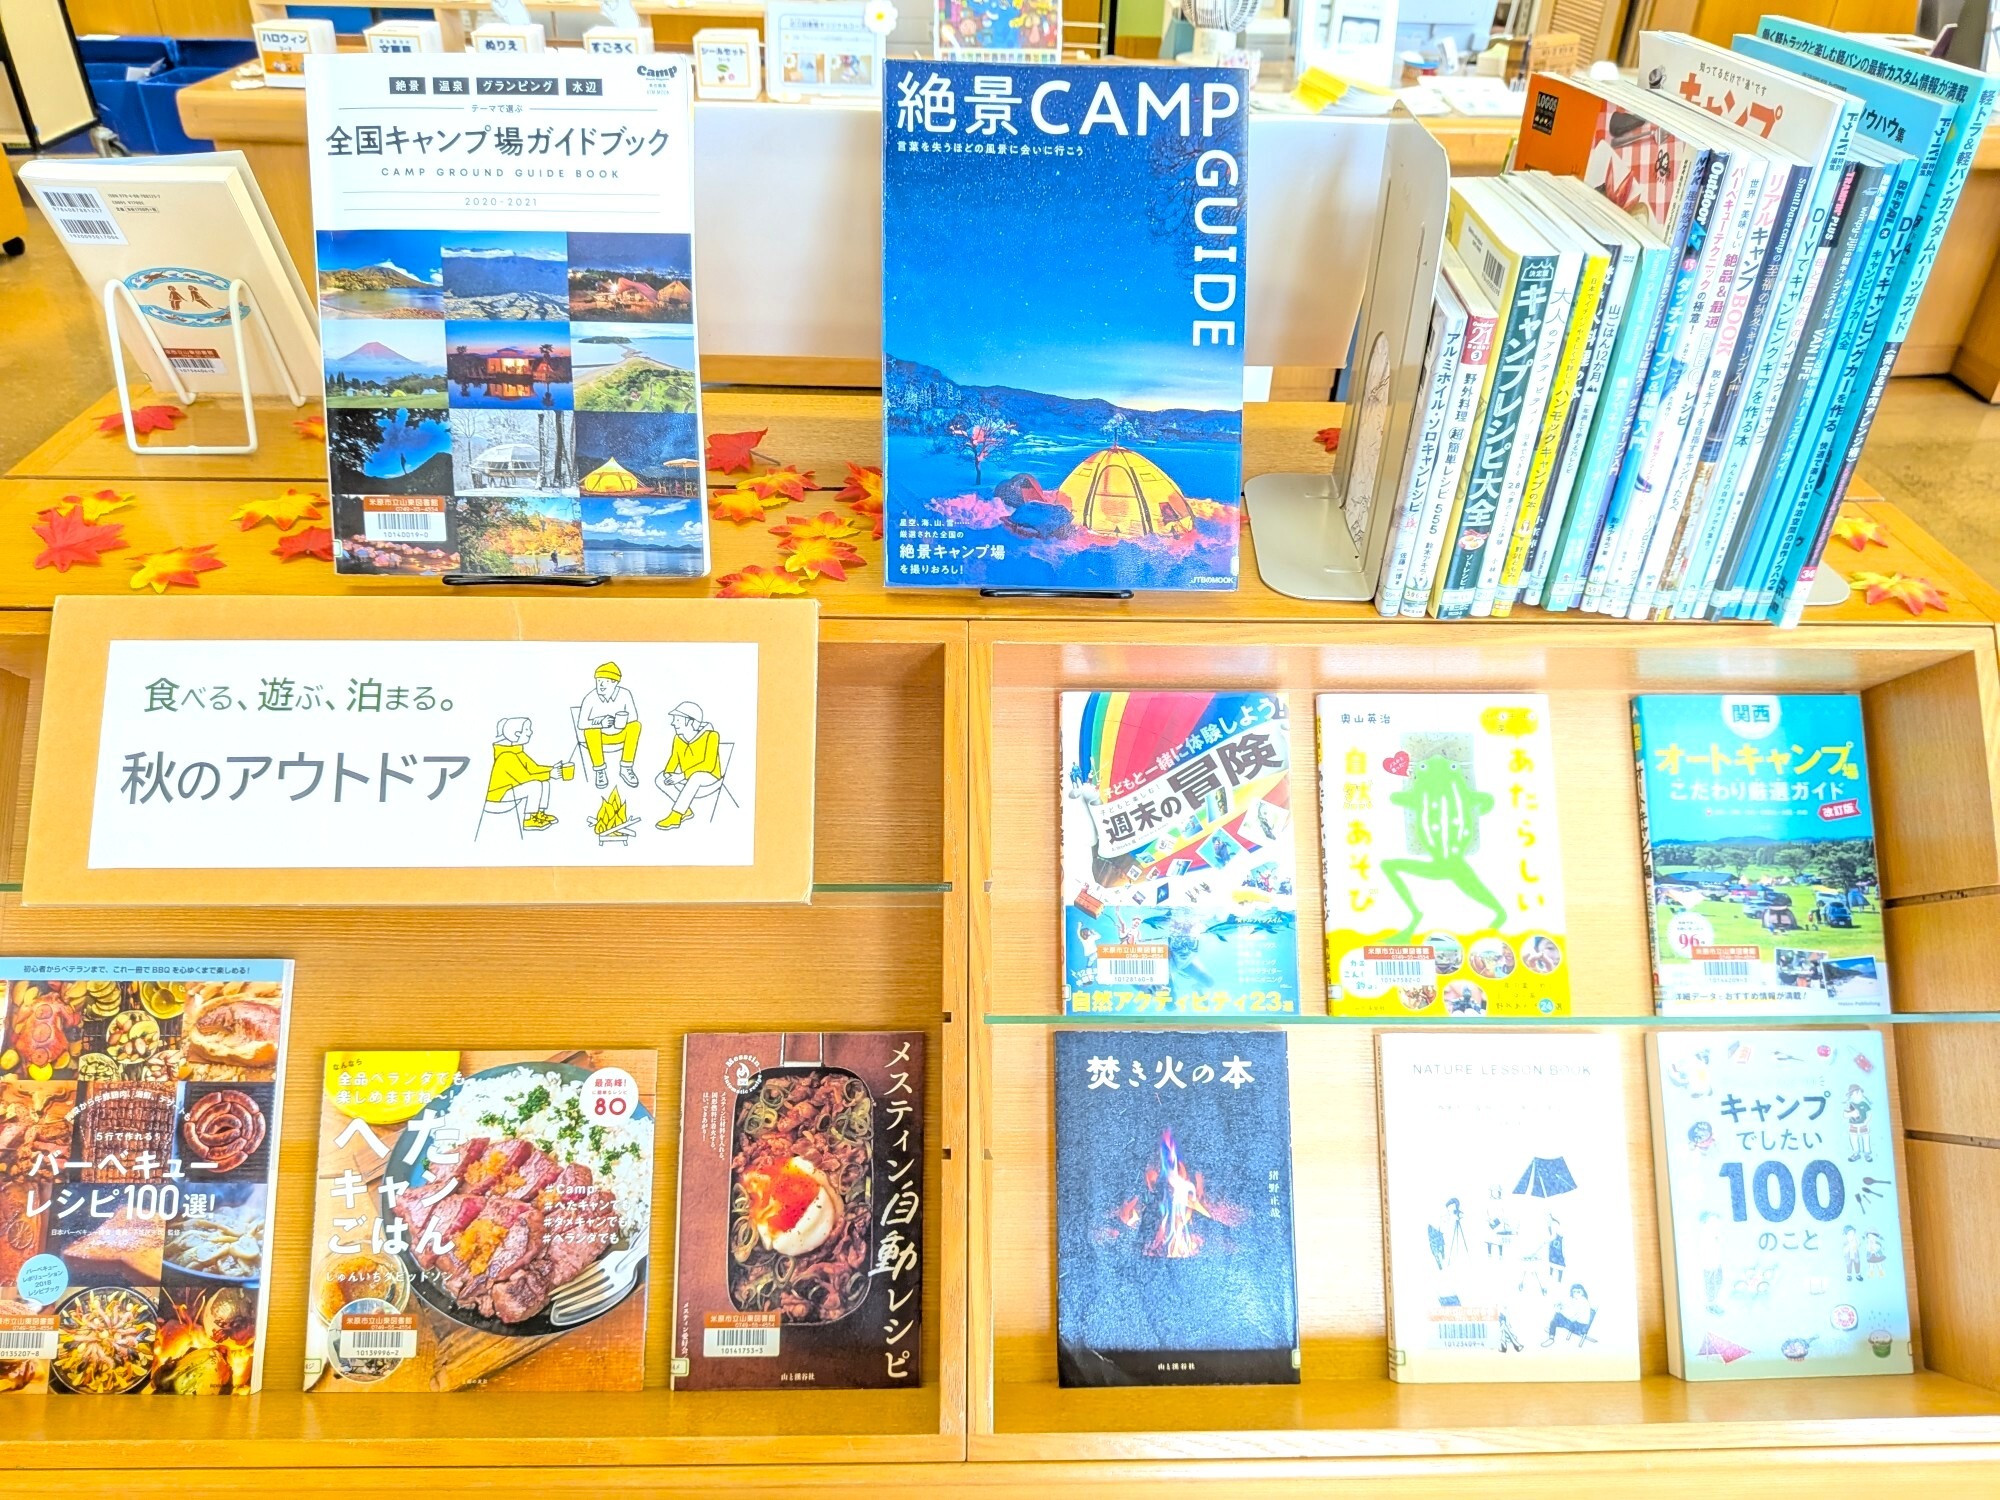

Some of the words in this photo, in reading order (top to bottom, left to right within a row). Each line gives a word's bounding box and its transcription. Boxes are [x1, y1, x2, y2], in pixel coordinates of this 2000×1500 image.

[262, 33, 307, 43] ハロウィン
[485, 39, 518, 52] ぬりえ
[591, 42, 633, 54] すごろく
[637, 65, 678, 80] Camp
[395, 79, 420, 93] 絶景
[438, 80, 464, 93] 温泉
[482, 80, 554, 94] グランピング
[571, 80, 598, 94] 水辺
[471, 104, 523, 114] テーマで選ぶ
[325, 124, 670, 158] 全国キャンプ場ガイドブック
[897, 140, 1085, 157] 言葉を失うほどの風景に会いに行こう
[381, 168, 426, 177] CAMP
[436, 168, 505, 178] GROUND
[515, 168, 566, 178] GUIDE
[575, 169, 620, 179] BOOK
[464, 196, 539, 207] 2020-2021
[1697, 162, 1724, 225] Outdoor
[1192, 149, 1240, 348] GUIDE
[1468, 327, 1493, 345] 21
[1588, 303, 1622, 383] 山ごはん12か月
[1454, 372, 1478, 422] 野外料理
[1462, 284, 1547, 527] キャンプレシピ大全
[1409, 332, 1461, 513] アルミホイル・ソロキャンレシピ
[1525, 388, 1571, 509] ハンモックキャンプの本
[900, 531, 964, 539] 厳選された全国の
[899, 544, 1006, 561] 絶景キャンプ場
[900, 564, 964, 575] を撮りおろし!
[144, 677, 455, 713] 食べる、遊ぶ、泊まる。
[1341, 713, 1391, 725] 奥山英治
[1732, 704, 1771, 723] 関西
[1102, 697, 1287, 800] 子どもと一緒に体験しよう!
[121, 751, 471, 805] 秋のアウトドア
[1822, 802, 1856, 818] 改訂版
[1342, 748, 1375, 913] 自然あそび
[1507, 748, 1545, 913] あたらしい
[152, 966, 170, 974] BBQ
[333, 1058, 363, 1071] なんなら
[1086, 1055, 1256, 1091] 焚き火の本
[1413, 1064, 1474, 1076] NATURE
[1482, 1064, 1543, 1076] LESSON
[338, 1070, 466, 1088] 全品ベランダでも
[594, 1097, 627, 1116] 80
[1720, 1090, 1832, 1124] キャンプ
[334, 1107, 461, 1166] へた
[1736, 1129, 1823, 1151] でしたい
[28, 1150, 219, 1180] バーベキュー
[330, 1168, 459, 1210] キャン
[1719, 1159, 1846, 1223] 100
[26, 1184, 216, 1220] レシピ100選!
[867, 1041, 920, 1378] メスティン自動レシピ
[328, 1216, 457, 1255] ごはん
[1758, 1230, 1820, 1251] のこと
[0, 1318, 54, 1326] 市立山東図書館
